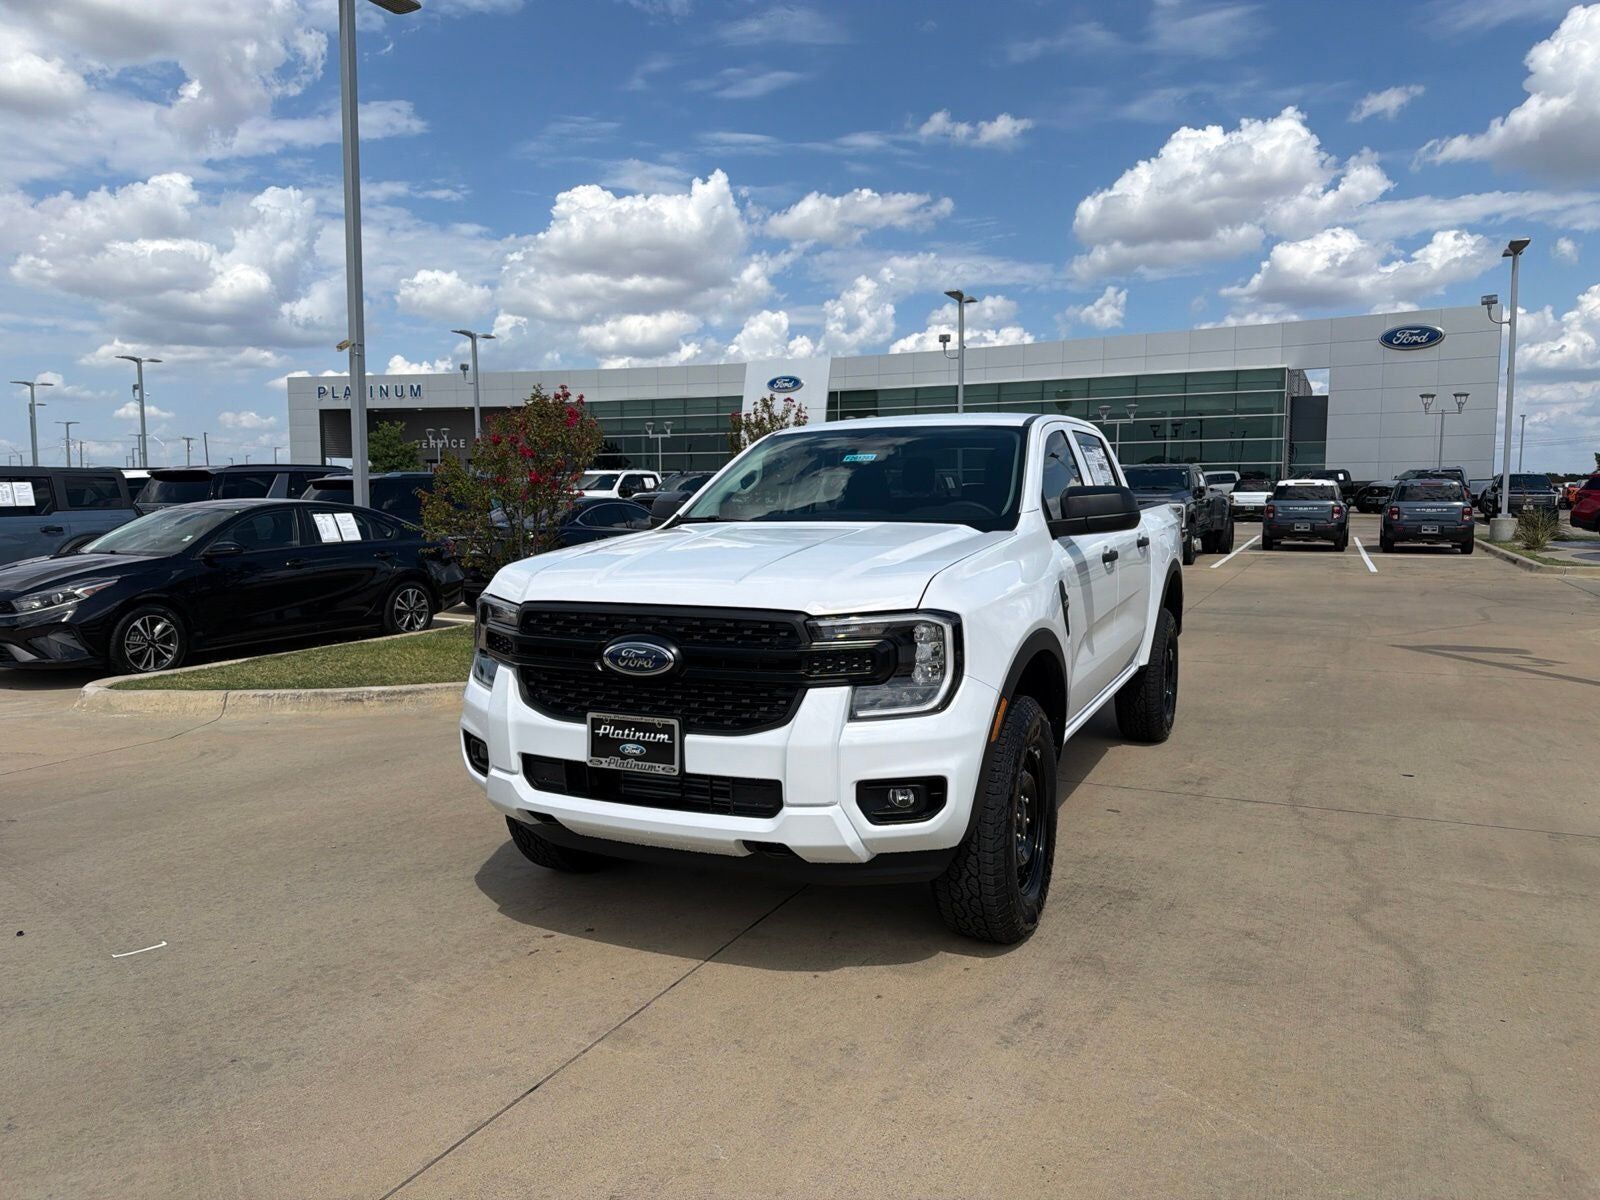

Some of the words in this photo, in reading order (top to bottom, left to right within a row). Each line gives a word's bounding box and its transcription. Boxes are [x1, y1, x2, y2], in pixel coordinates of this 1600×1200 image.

[1392, 329, 1430, 345] Ford
[317, 384, 422, 399] PLAINUM
[773, 378, 795, 389] Ford
[617, 648, 656, 669] Ford
[594, 724, 673, 743] Platinum
[623, 745, 642, 755] Ford
[607, 757, 660, 773] Platinum
